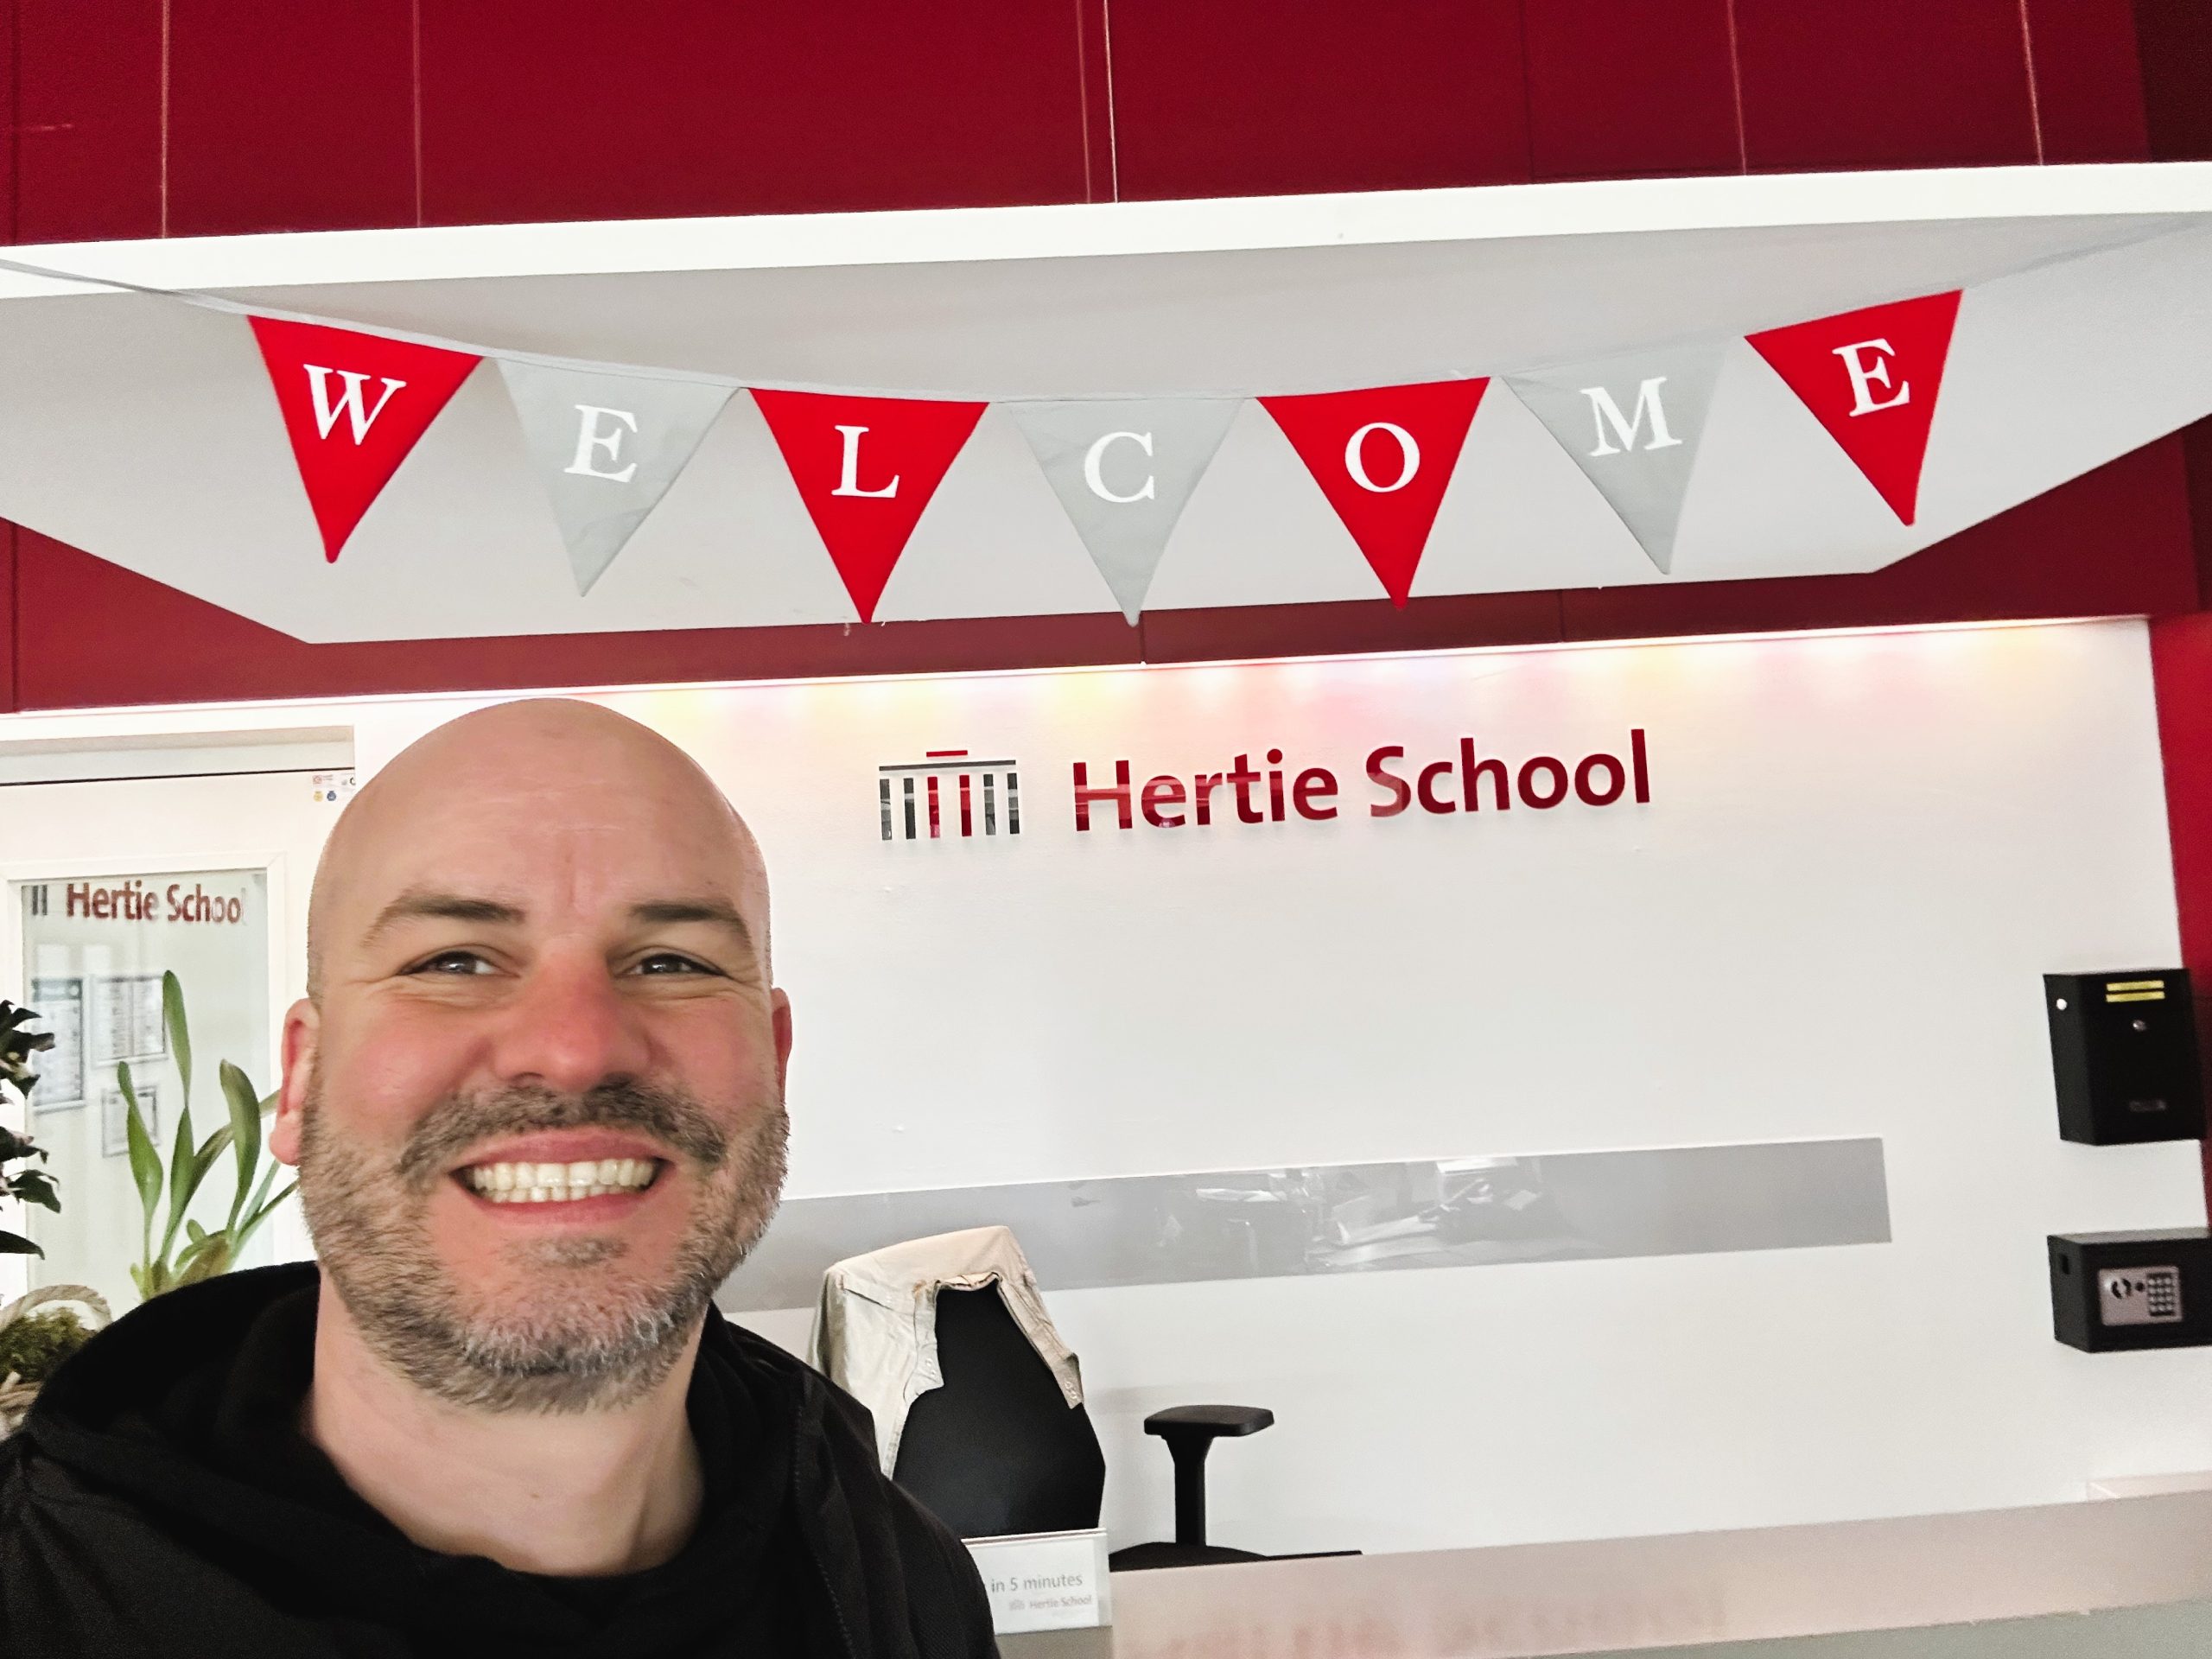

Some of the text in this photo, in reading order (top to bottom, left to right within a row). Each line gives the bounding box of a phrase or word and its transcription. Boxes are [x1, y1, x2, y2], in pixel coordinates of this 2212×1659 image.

[302, 338, 1910, 503] WELCOME
[1073, 728, 1649, 831] Hertie School
[67, 880, 158, 920] Hertie
[991, 1574, 1084, 1592] in 5 minutes
